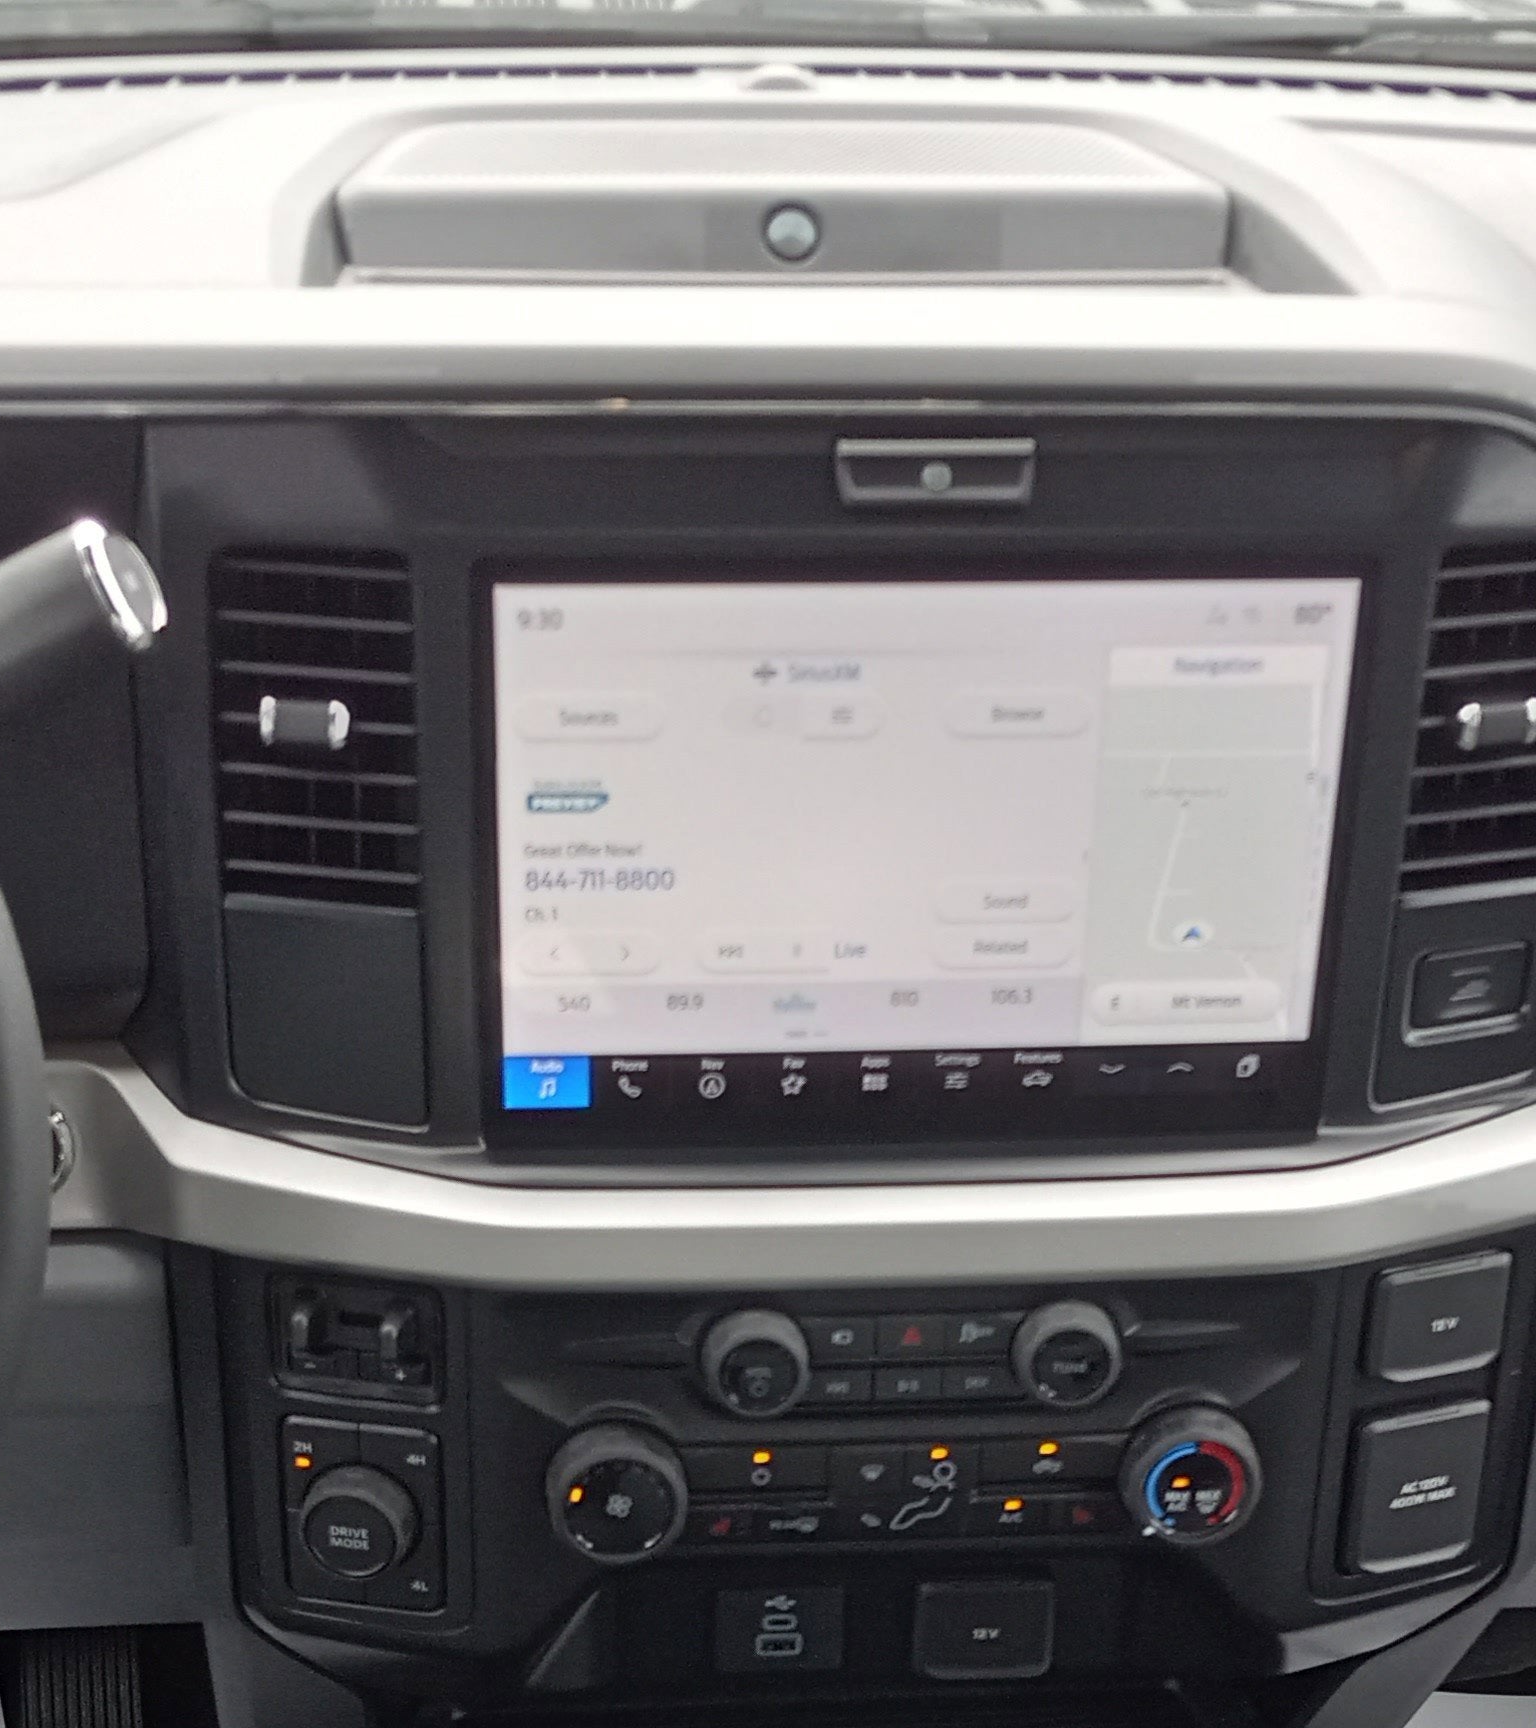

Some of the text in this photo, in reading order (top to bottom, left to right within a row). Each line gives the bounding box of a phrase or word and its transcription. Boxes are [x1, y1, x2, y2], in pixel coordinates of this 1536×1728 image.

[1173, 657, 1263, 679] Navigation
[524, 844, 562, 859] Great
[566, 842, 602, 858] Offer
[525, 870, 675, 892] 844-711-8800
[983, 893, 1030, 911] Sound
[834, 941, 866, 960] Live
[972, 937, 1030, 955] Related
[990, 984, 1033, 1005] 106.3
[612, 1059, 649, 1073] Phone
[934, 1052, 982, 1068] Settings
[1014, 1051, 1063, 1065] Features
[530, 1059, 564, 1074] Audio
[293, 1441, 313, 1453] 2H
[330, 1526, 369, 1538] DRIVE
[330, 1538, 370, 1550] MODE
